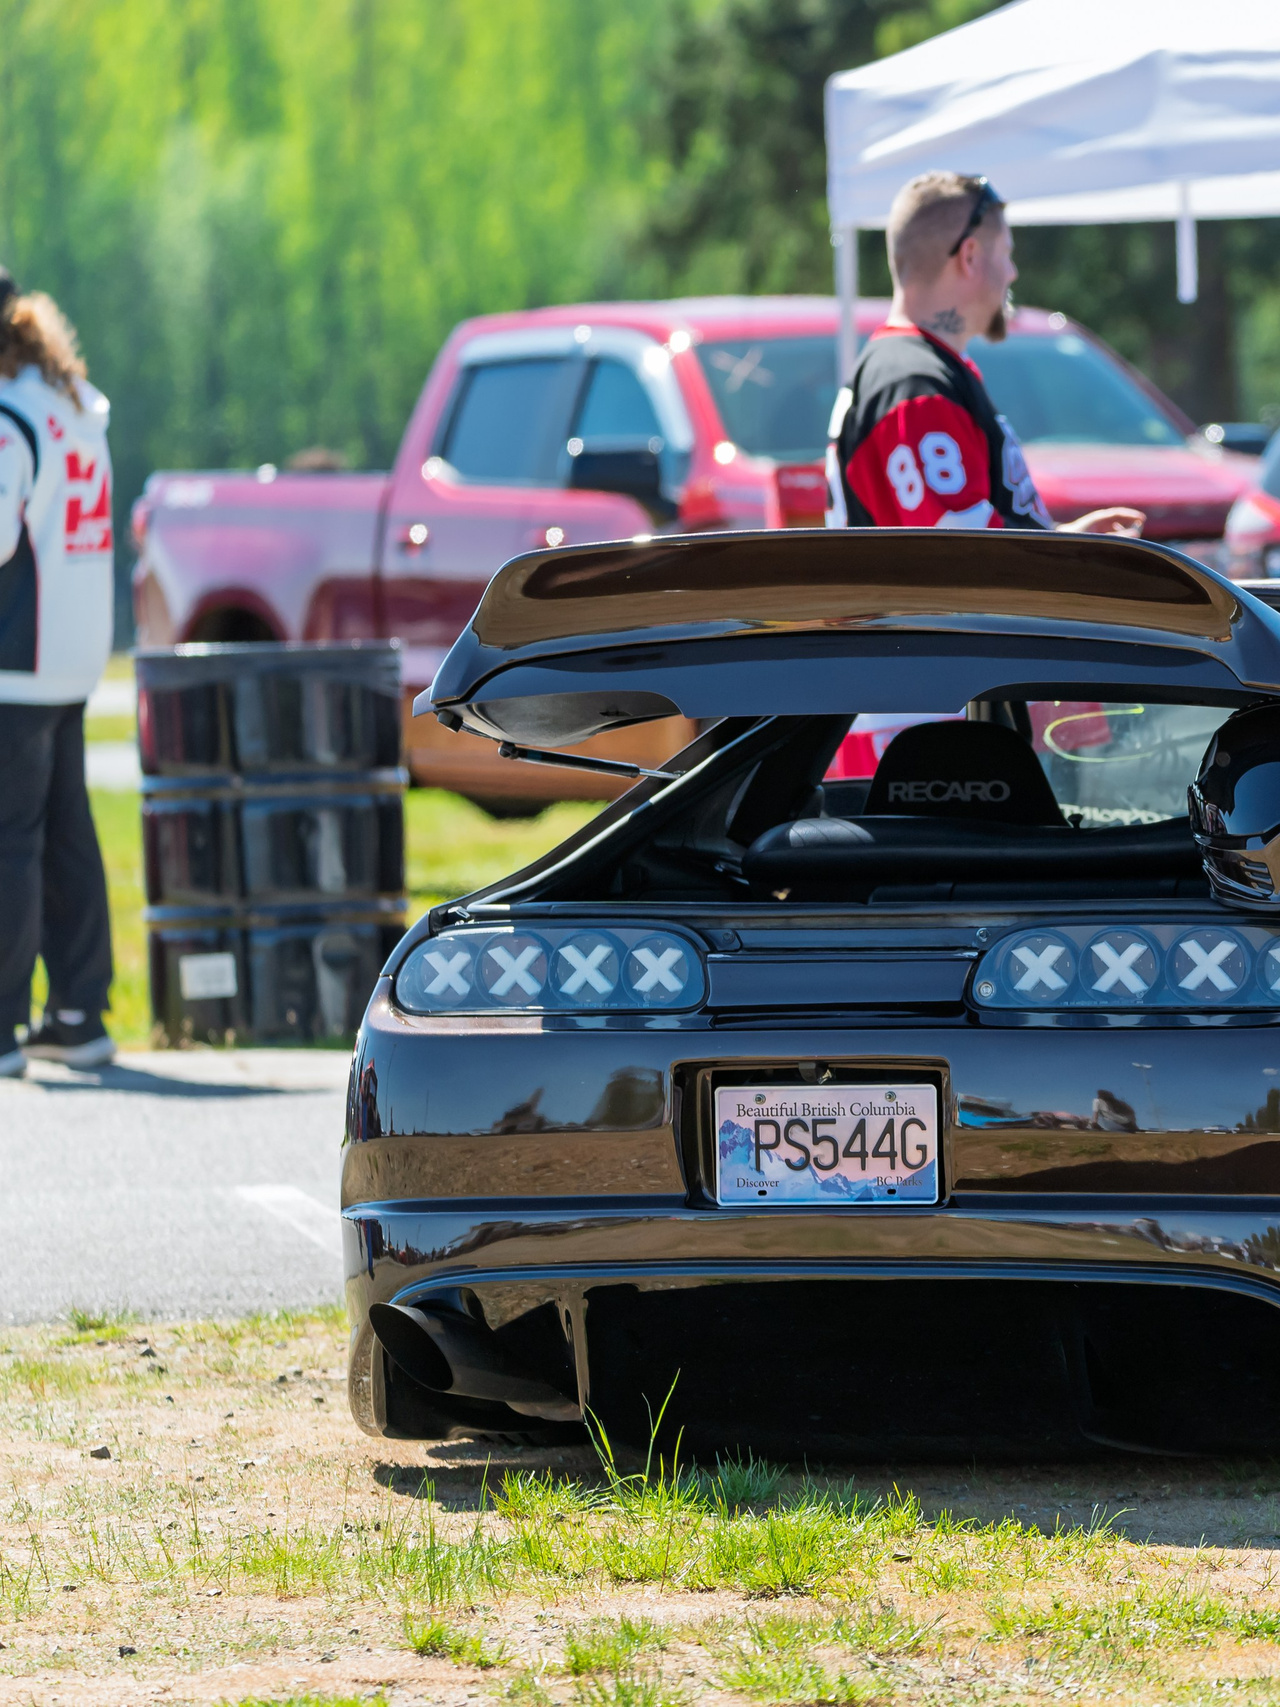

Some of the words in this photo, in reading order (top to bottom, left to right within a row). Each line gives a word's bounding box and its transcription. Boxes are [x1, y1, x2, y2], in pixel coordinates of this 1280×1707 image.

[887, 431, 967, 511] 88
[888, 780, 1011, 803] RECARO
[736, 1103, 798, 1118] Beautiful
[801, 1102, 846, 1117] British
[849, 1101, 916, 1117] Columbia
[754, 1117, 928, 1172] PS544G
[736, 1177, 780, 1188] Discover
[876, 1175, 893, 1187] BC
[896, 1175, 923, 1187] Parks
